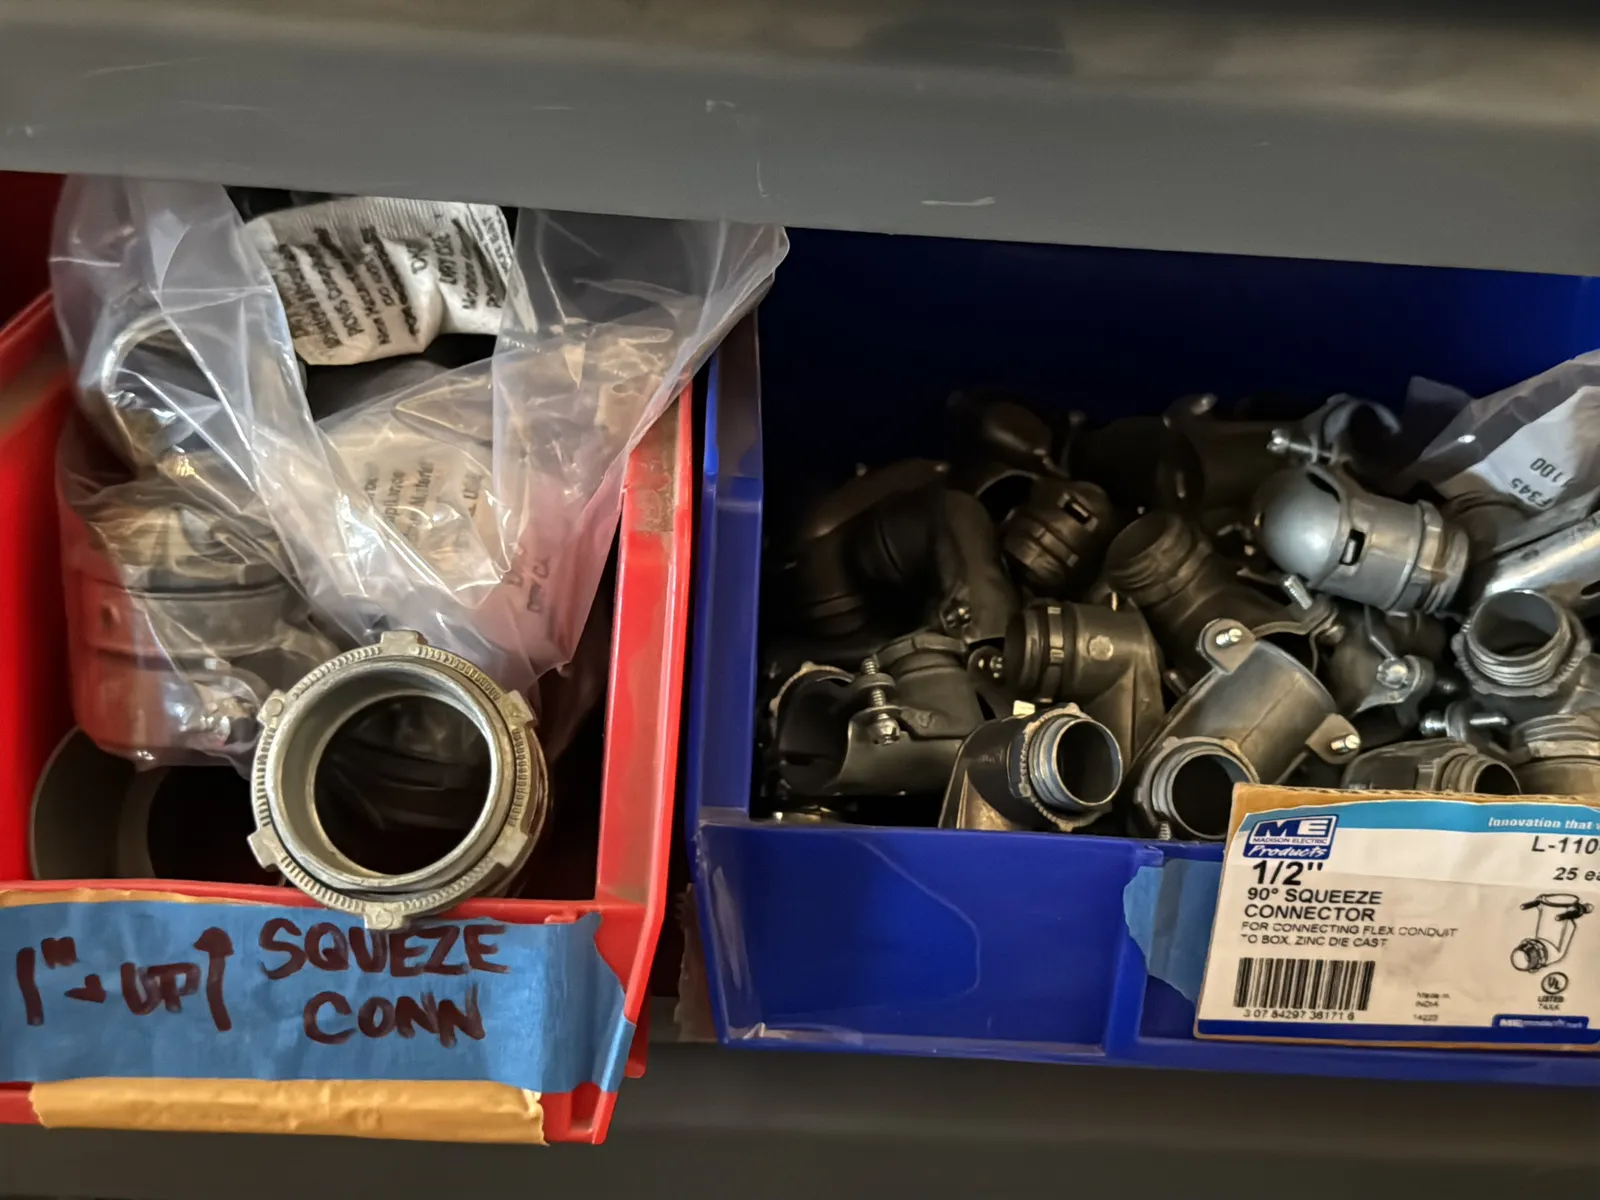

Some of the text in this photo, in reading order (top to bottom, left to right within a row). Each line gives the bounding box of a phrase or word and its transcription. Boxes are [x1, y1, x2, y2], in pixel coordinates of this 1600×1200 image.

[1254, 819, 1330, 837] ME
[1488, 817, 1561, 828] Innovation
[1565, 819, 1592, 830] that
[1247, 844, 1327, 858] Products
[1252, 860, 1323, 885] 1/2"
[1553, 867, 1579, 880] 25
[1247, 887, 1383, 905] 90° SQUEEZE
[1244, 904, 1376, 922] CONNECTOR
[1240, 921, 1458, 938] FOR CONNECTING FLEX CONDUIT
[1295, 936, 1325, 946] ZINC
[1328, 937, 1349, 947] DIE
[303, 984, 486, 1049] CONN
